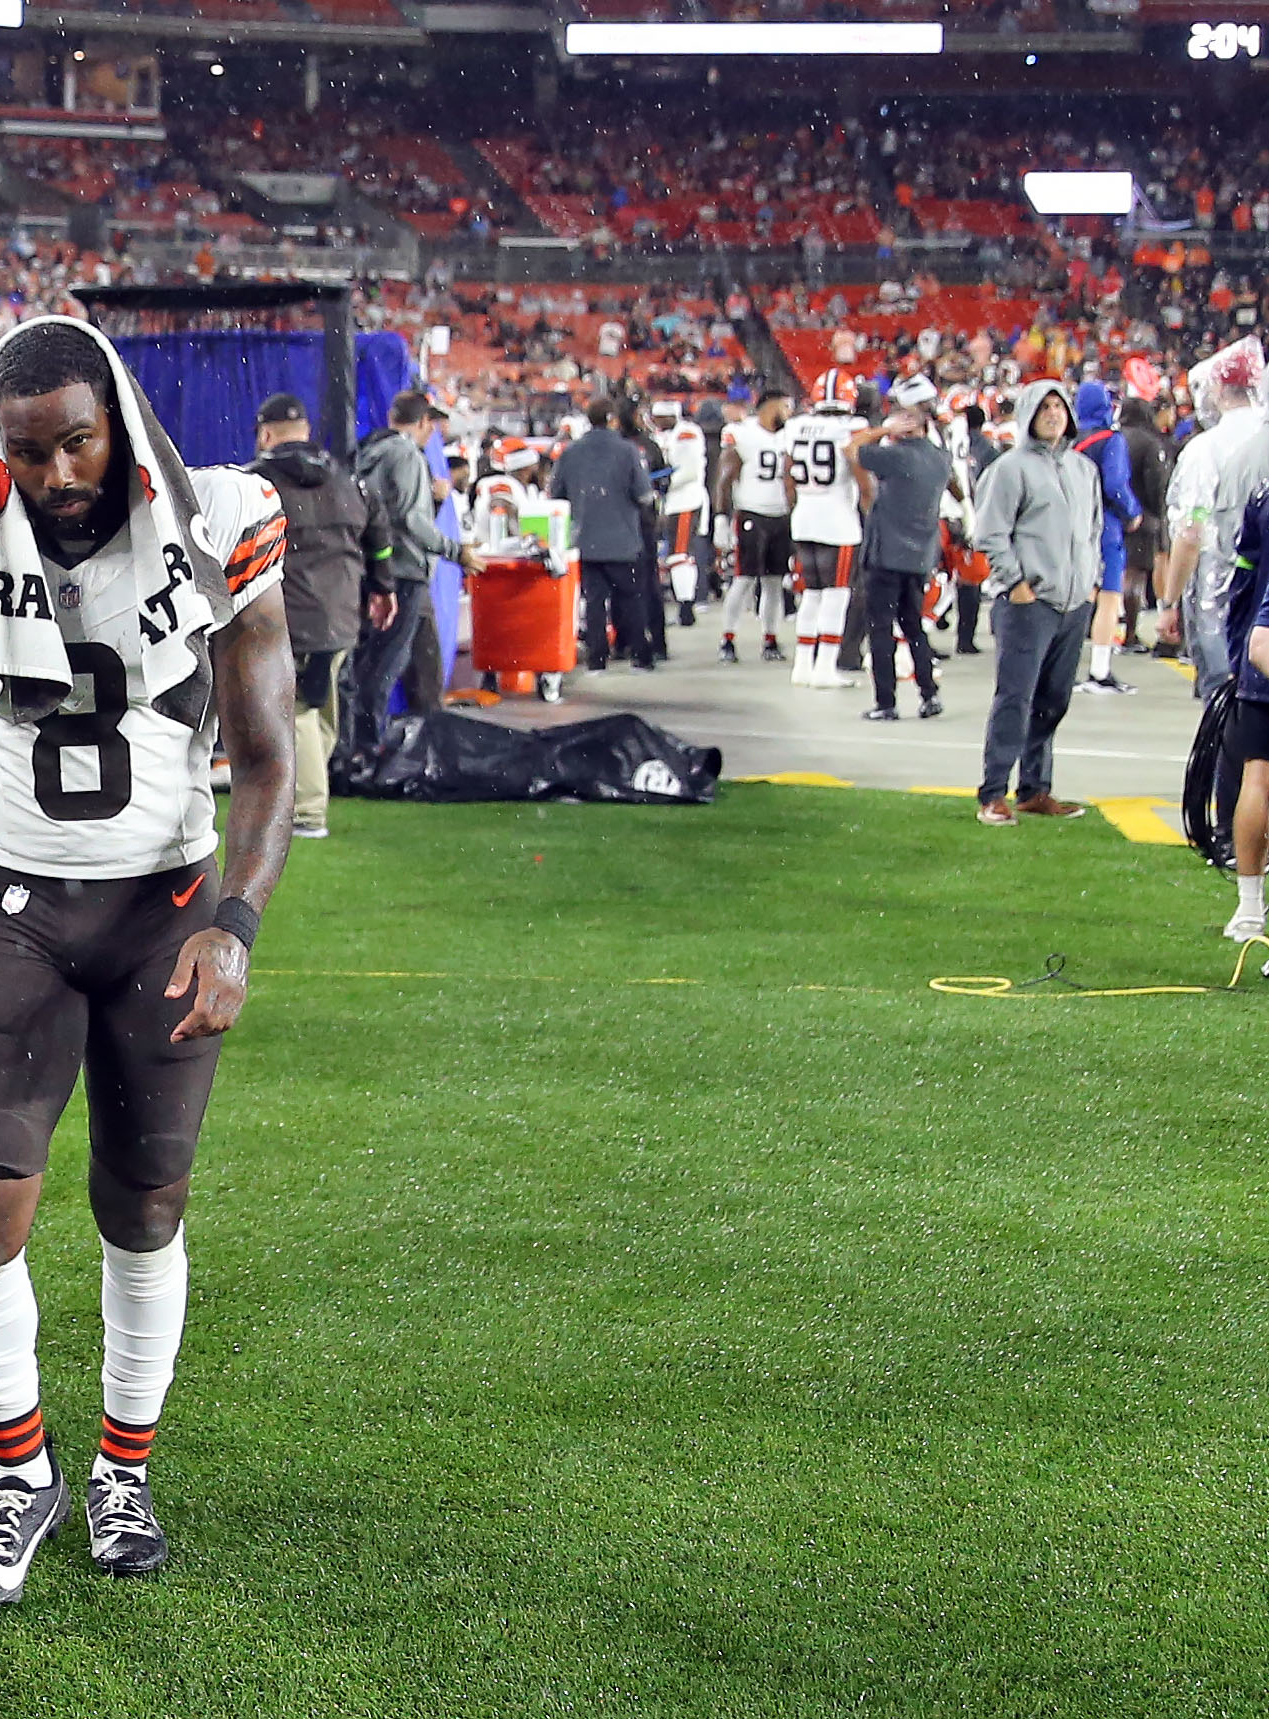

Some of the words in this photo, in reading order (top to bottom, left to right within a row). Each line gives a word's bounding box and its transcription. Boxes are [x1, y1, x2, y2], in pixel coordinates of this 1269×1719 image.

[1188, 22, 1260, 59] 2:04
[758, 451, 785, 480] 9
[792, 440, 835, 485] 59
[32, 642, 132, 821] 8
